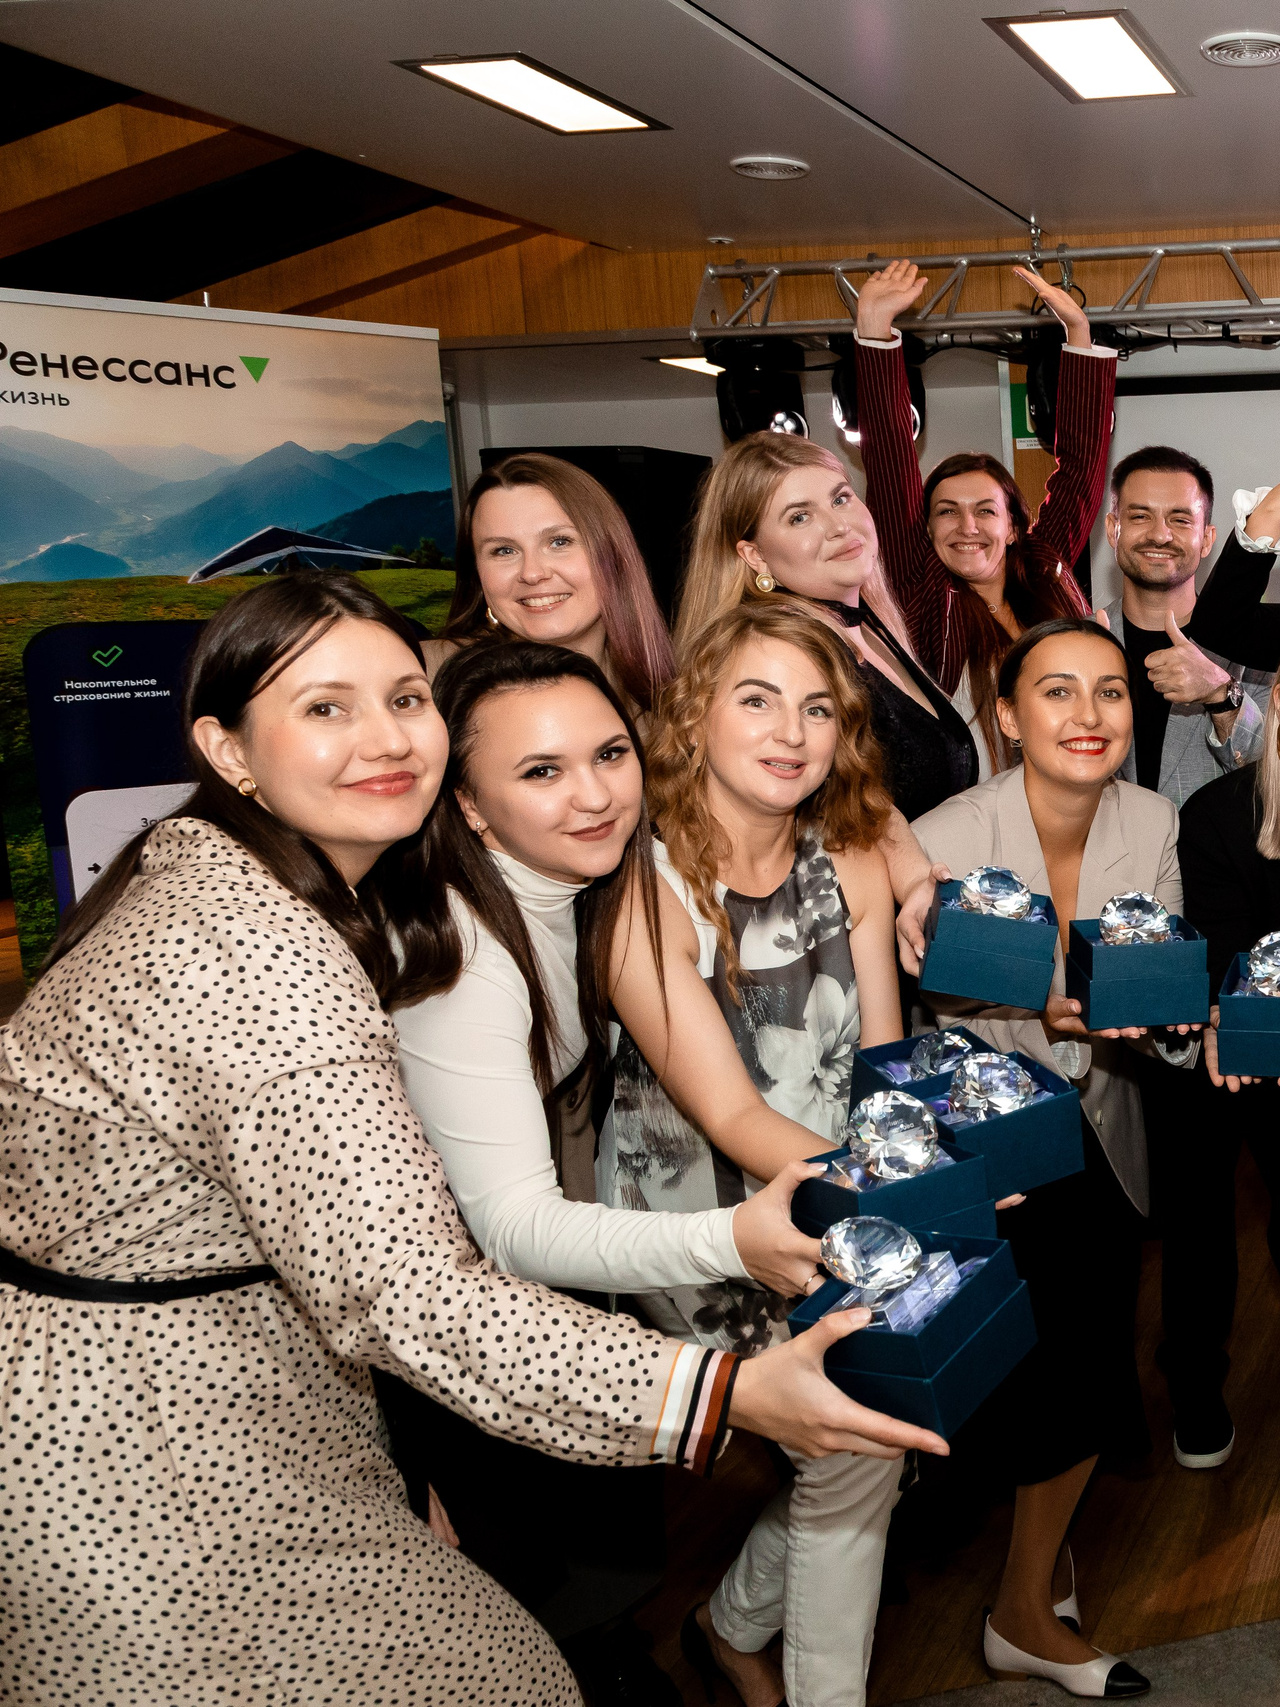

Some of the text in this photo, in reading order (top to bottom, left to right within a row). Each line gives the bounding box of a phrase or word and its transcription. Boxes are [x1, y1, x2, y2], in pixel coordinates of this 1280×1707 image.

[64, 678, 157, 690] Накопительное
[53, 689, 171, 703] страхование жизни
